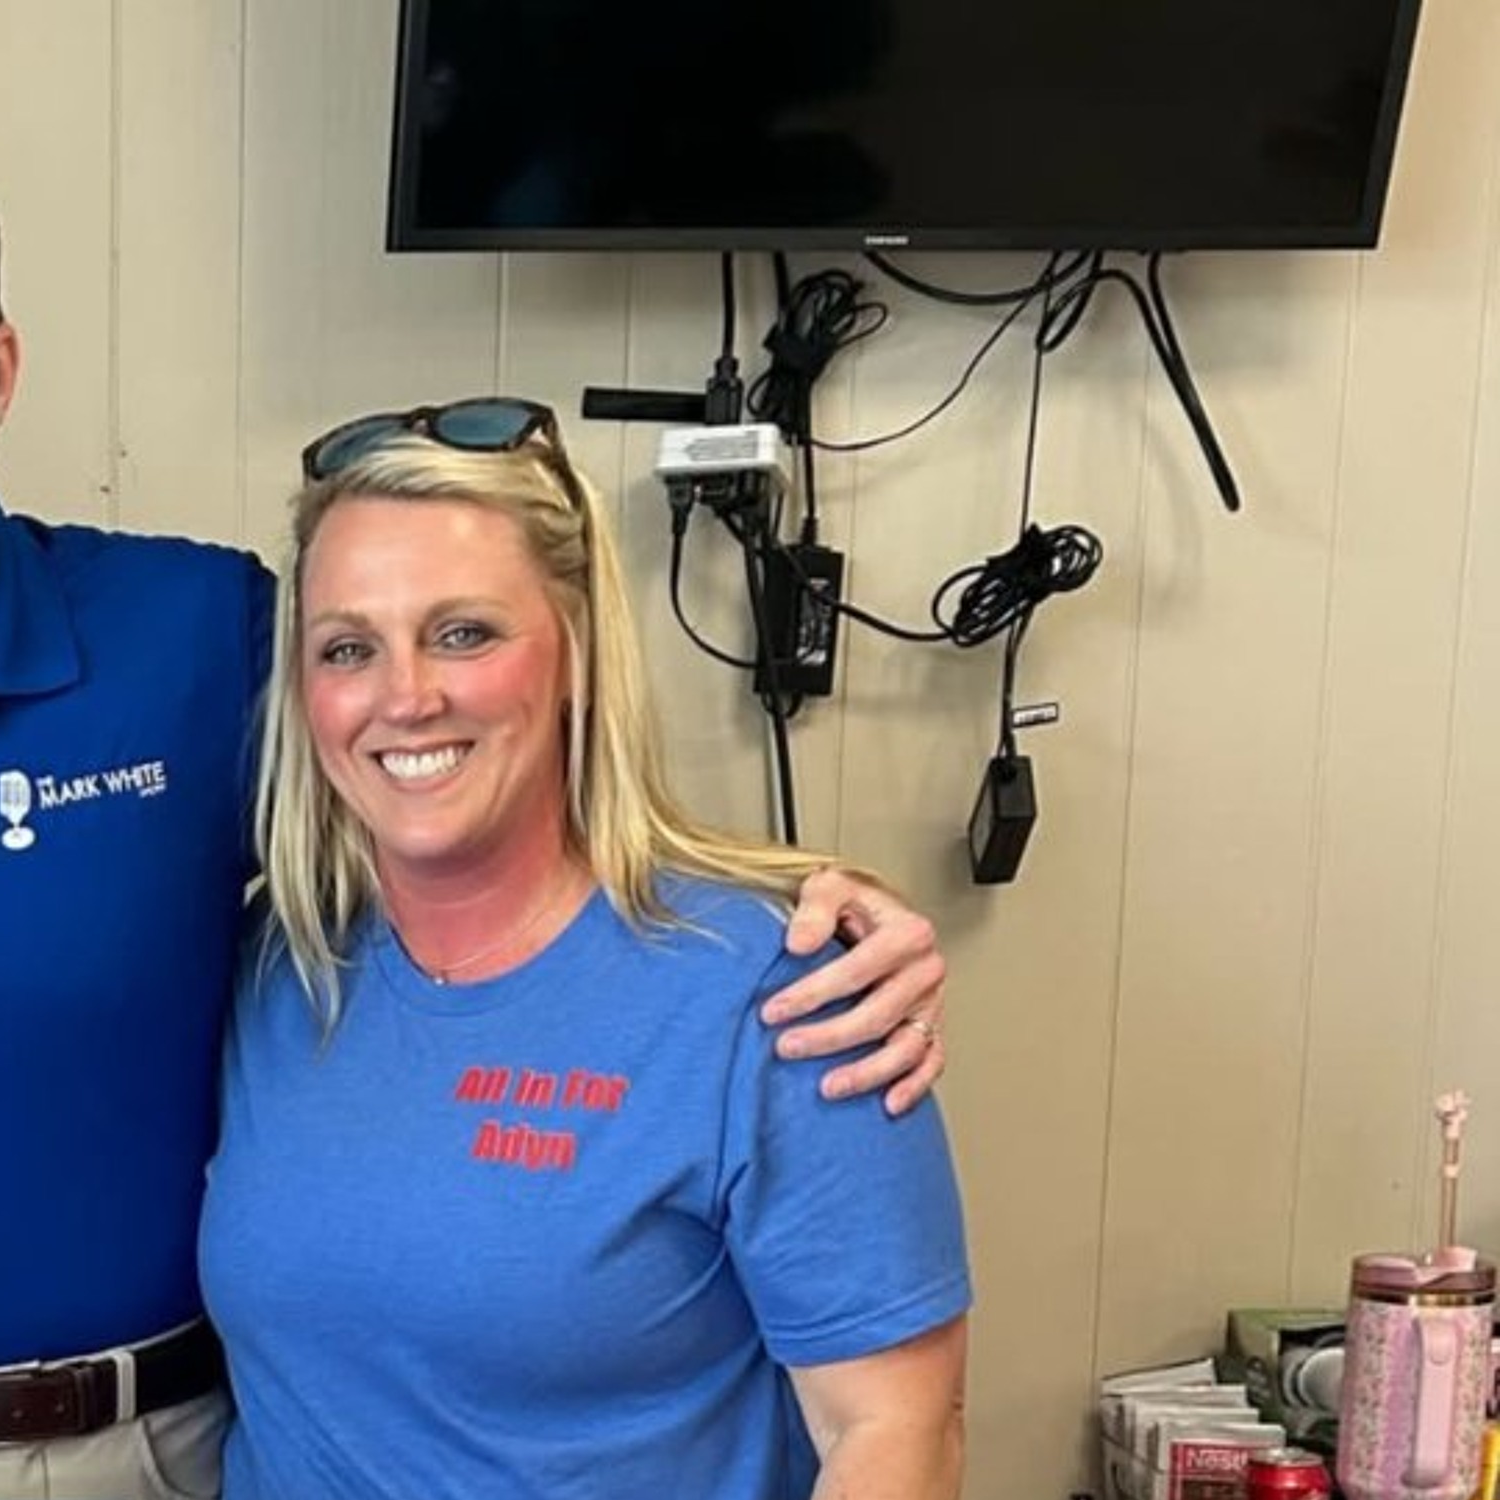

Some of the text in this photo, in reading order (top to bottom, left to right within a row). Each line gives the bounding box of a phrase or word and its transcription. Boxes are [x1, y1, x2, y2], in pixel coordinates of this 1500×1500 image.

[39, 775, 101, 810] MARK
[102, 760, 166, 794] WHITE
[456, 1065, 630, 1114] All In For
